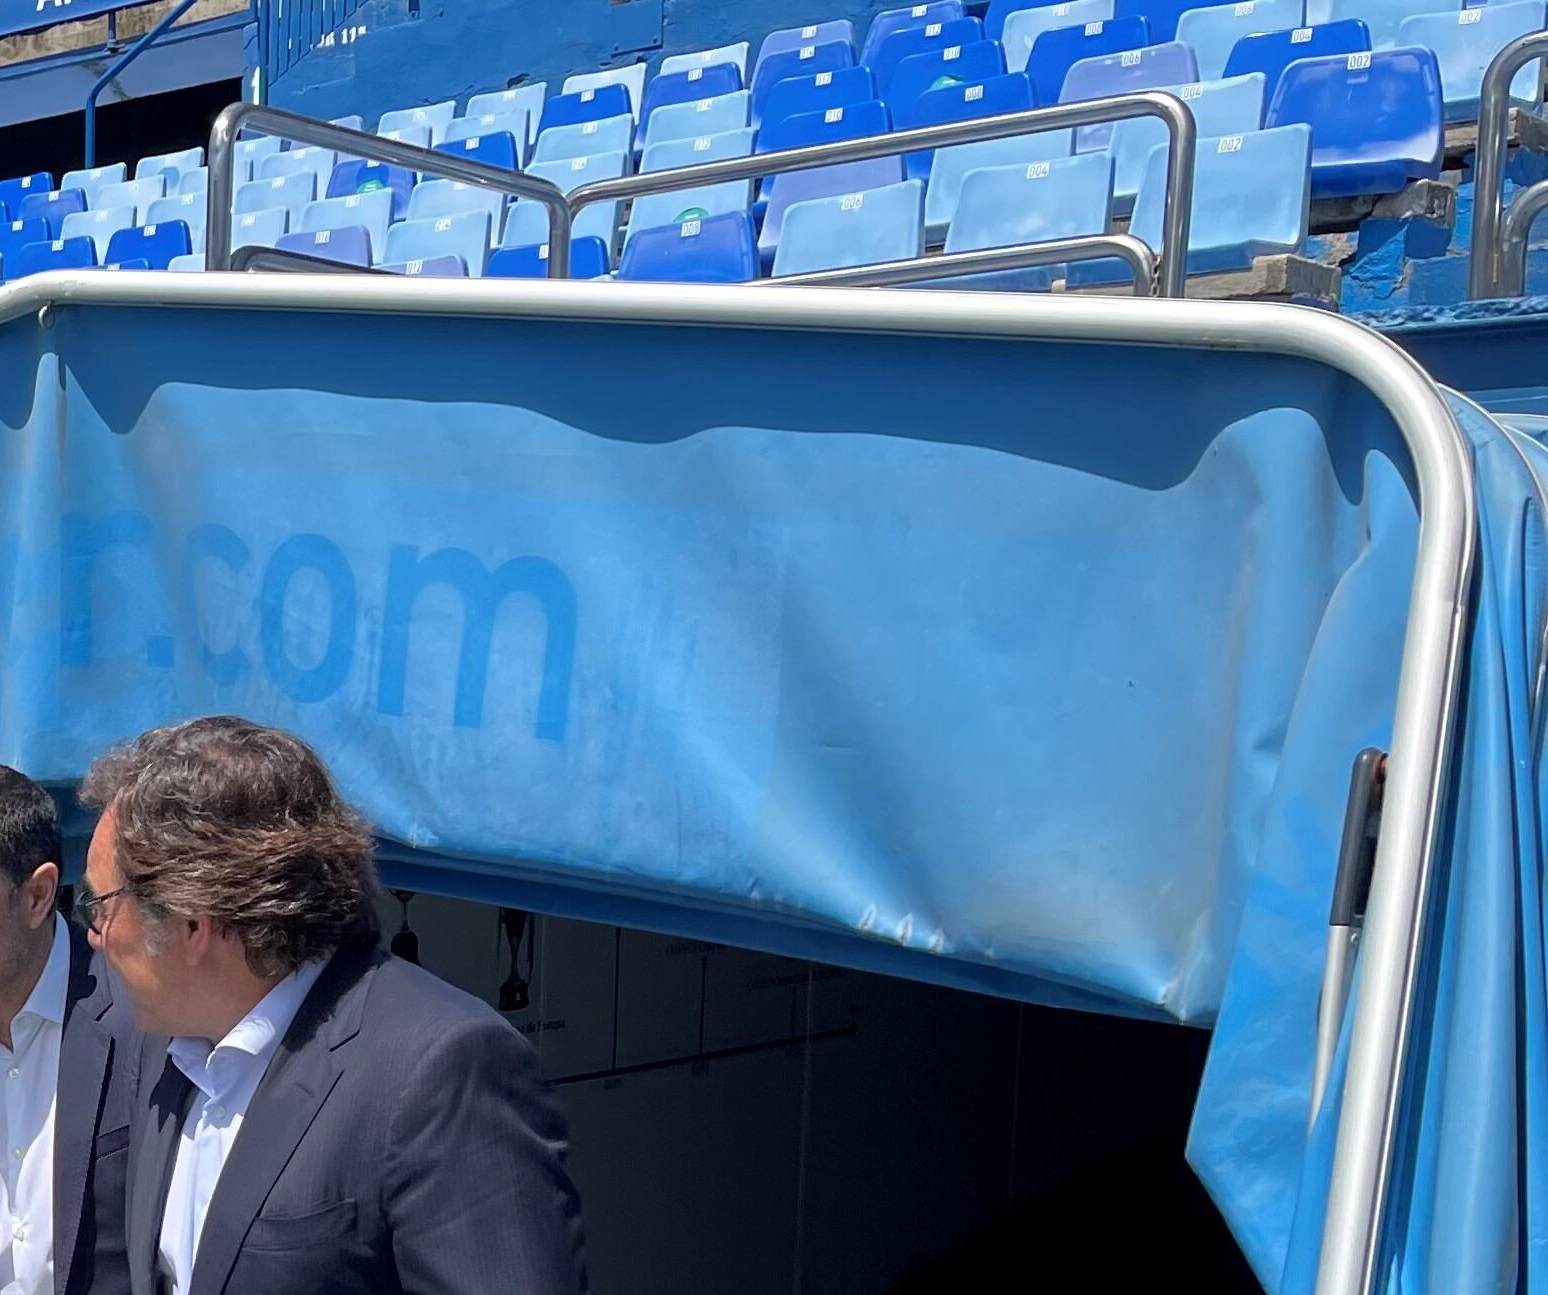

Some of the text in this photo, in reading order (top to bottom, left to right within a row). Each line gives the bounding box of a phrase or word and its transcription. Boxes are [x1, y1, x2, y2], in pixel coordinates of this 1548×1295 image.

[1293, 29, 1310, 42] 004
[1350, 54, 1370, 69] 002
[1220, 138, 1241, 151] 002
[1029, 164, 1048, 177] 004
